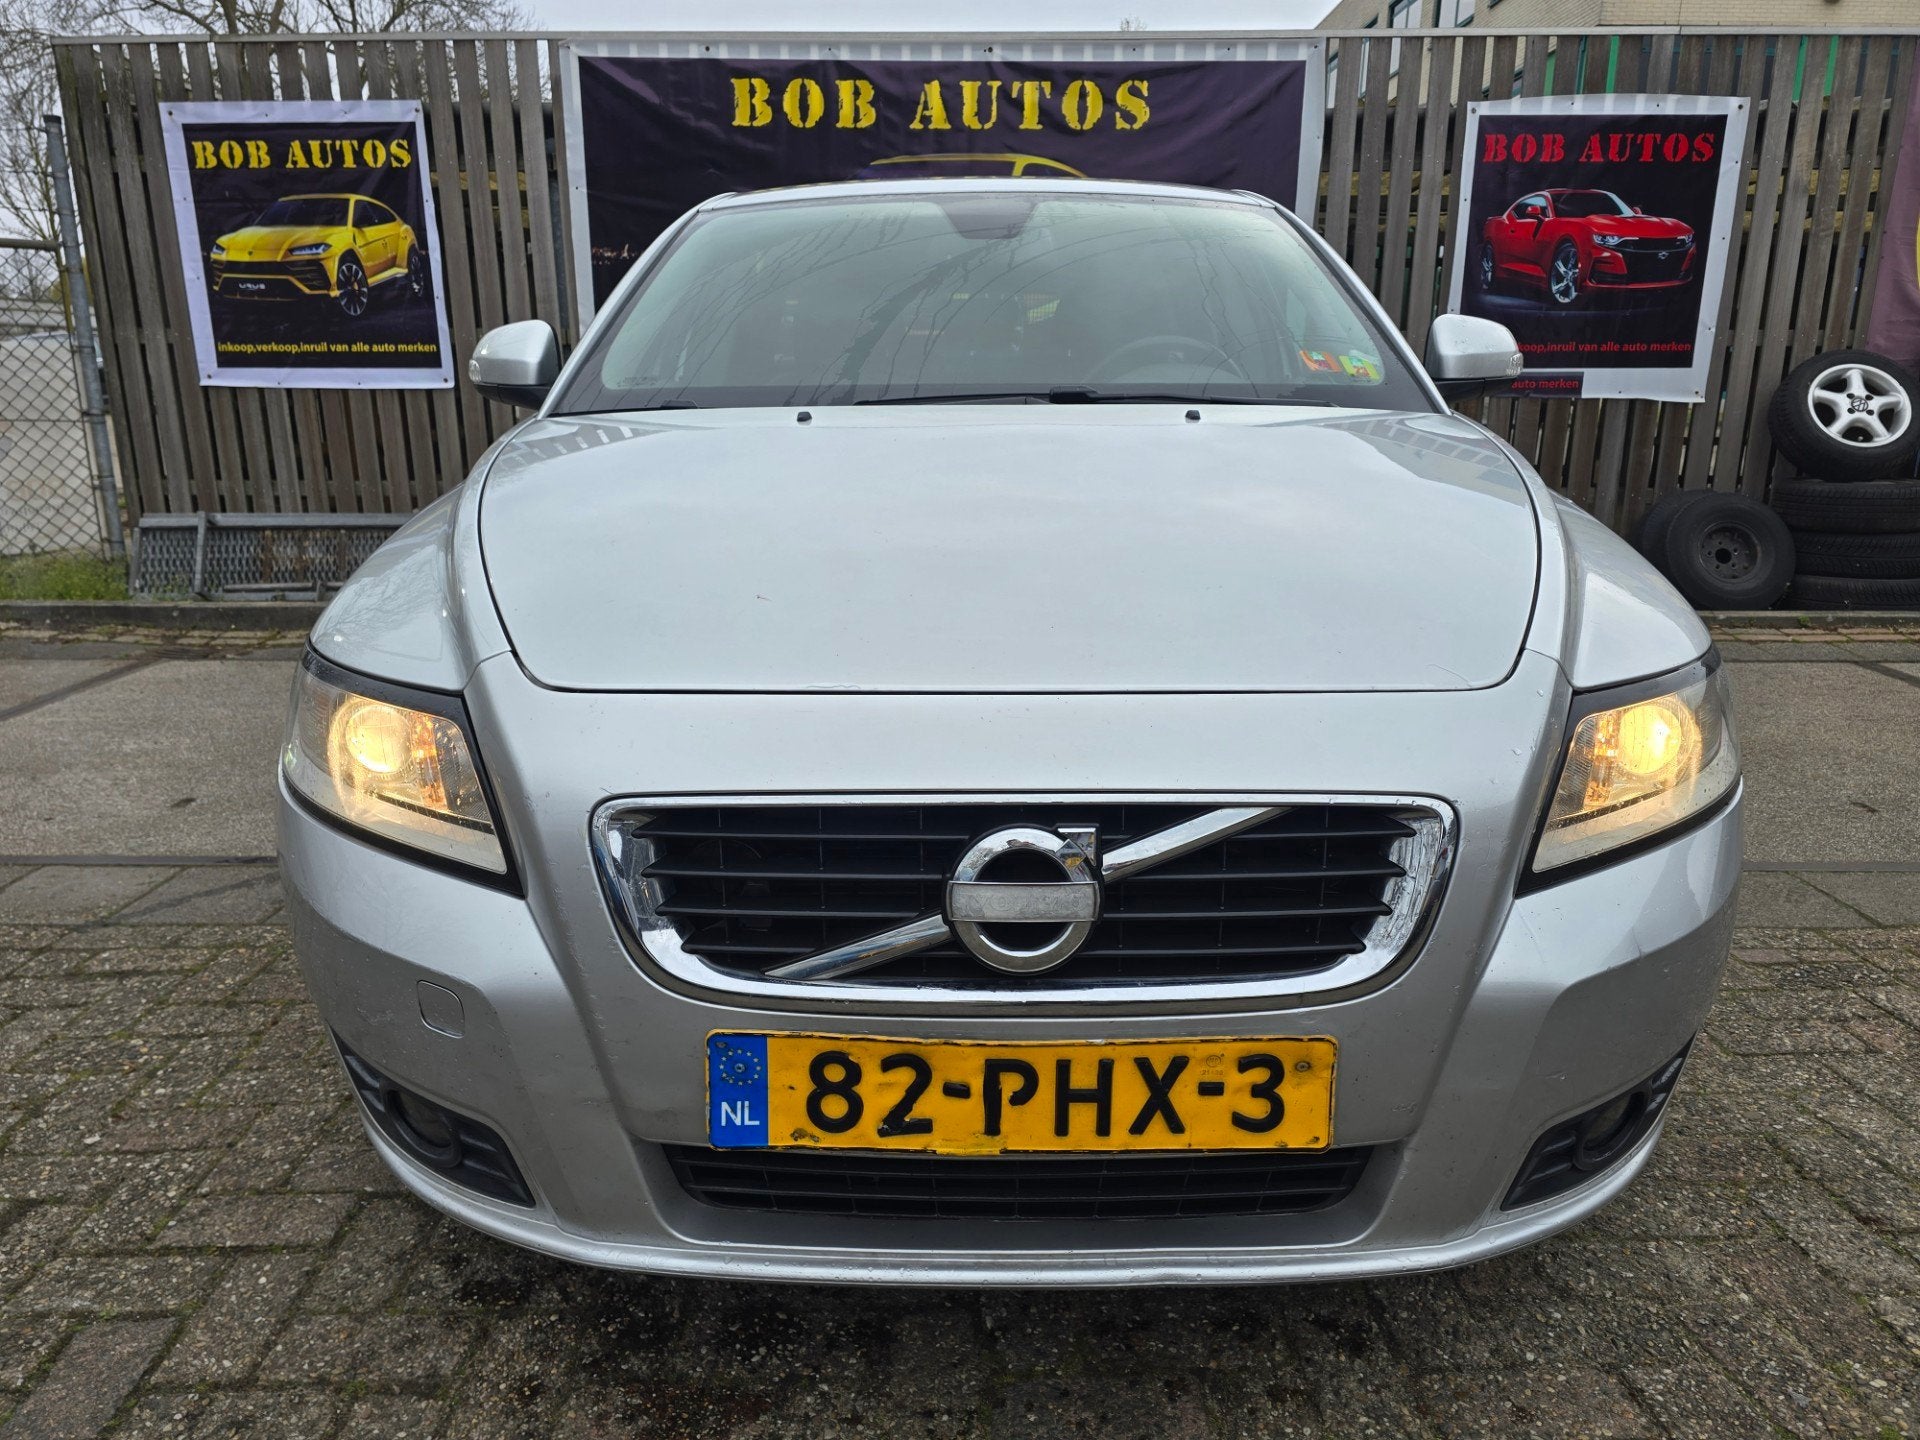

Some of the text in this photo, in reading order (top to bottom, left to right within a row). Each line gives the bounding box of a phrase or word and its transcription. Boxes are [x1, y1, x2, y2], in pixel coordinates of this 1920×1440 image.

[730, 77, 1151, 131] BOB AUTOS
[191, 138, 412, 169] BOB AUTOS
[1482, 133, 1715, 163] BOB AUTOS
[329, 343, 349, 352] van
[351, 341, 370, 352] alle
[372, 342, 396, 353] auto
[397, 341, 437, 352] merken
[1578, 343, 1598, 352] van
[1600, 341, 1620, 352] alle
[1622, 342, 1648, 352] auto
[1649, 341, 1692, 352] merken
[1538, 378, 1580, 389] merken
[805, 1050, 1286, 1138] 82-PHX-3
[720, 1100, 761, 1127] NL
